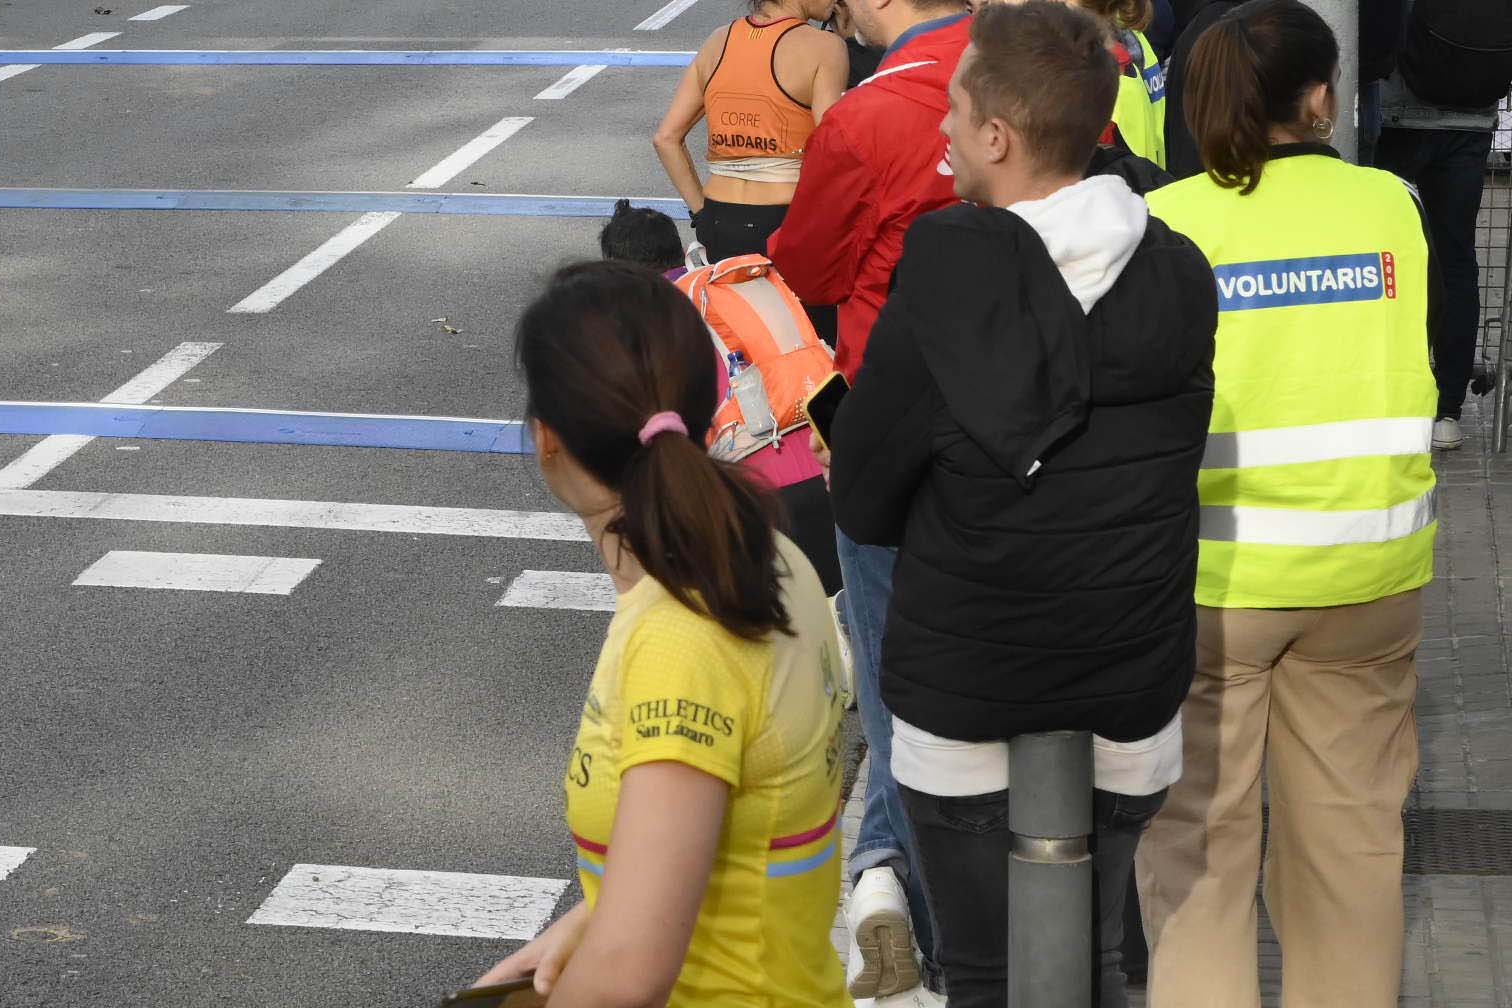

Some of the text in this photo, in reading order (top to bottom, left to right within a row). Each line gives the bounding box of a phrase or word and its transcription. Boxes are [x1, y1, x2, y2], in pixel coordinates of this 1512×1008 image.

[721, 111, 760, 128] CORRE
[712, 133, 777, 152] SOLIDARIS
[1218, 266, 1380, 299] VOLUNTARIS
[1384, 253, 1394, 298] 2000
[636, 723, 660, 739] San
